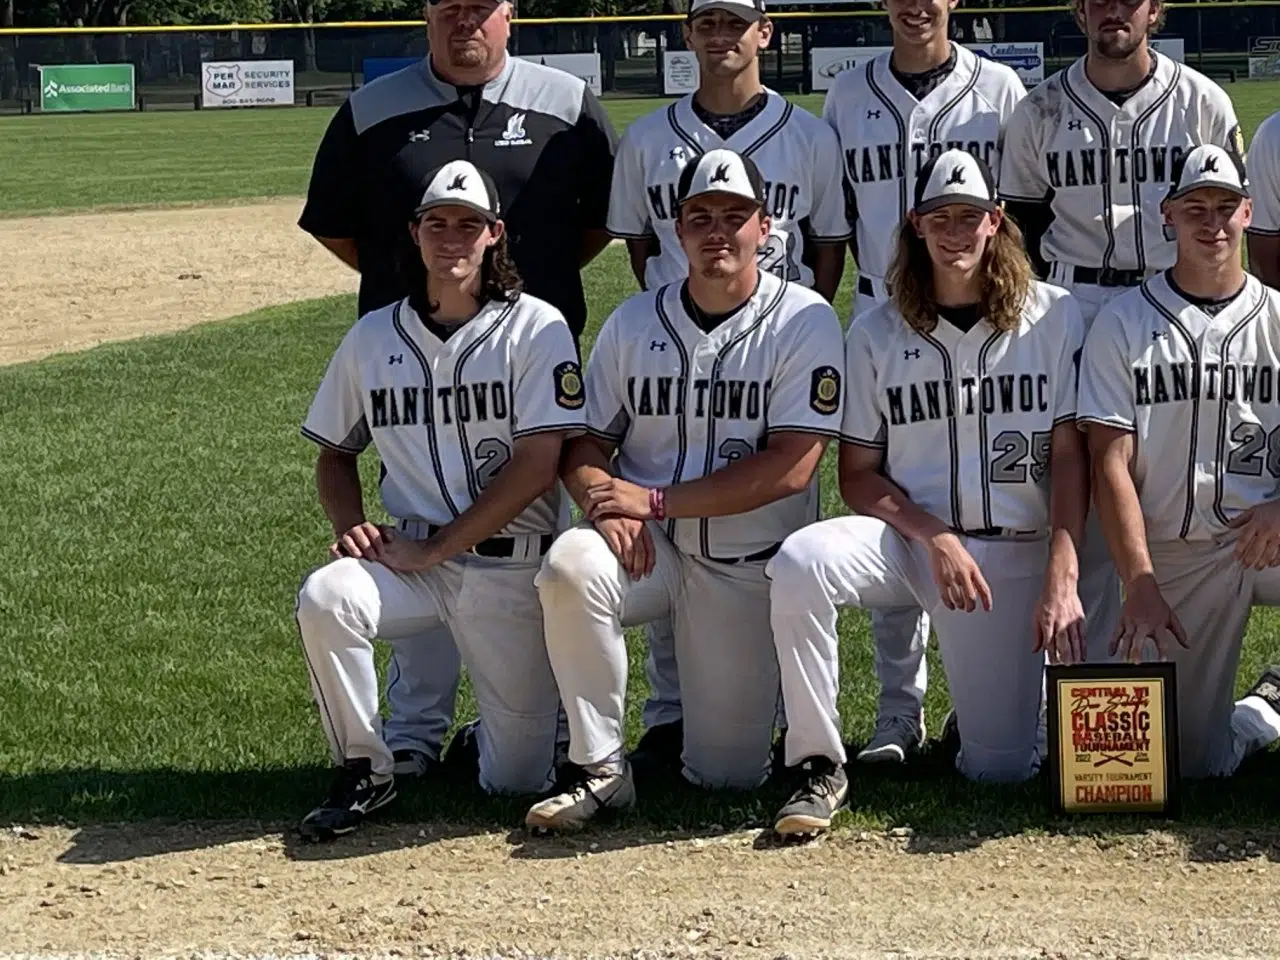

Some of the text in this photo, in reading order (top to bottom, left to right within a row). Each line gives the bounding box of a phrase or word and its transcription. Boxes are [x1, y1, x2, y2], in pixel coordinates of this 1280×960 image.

[213, 72, 234, 80] PER
[244, 70, 291, 80] SECURITY
[60, 83, 110, 94] Associated
[212, 82, 236, 90] MAR
[244, 80, 291, 89] SERVICES
[1046, 146, 1184, 188] MANITOW
[886, 374, 1050, 426] MANITOWOC
[1070, 687, 1127, 698] CENTRAL
[1070, 711, 1151, 731] CLASSIC
[1071, 731, 1150, 742] BASEBALL
[1072, 739, 1151, 752] TOURNAMENT
[1074, 771, 1153, 782] VARSITY TOURNAMENT
[1075, 784, 1153, 803] CHAMPION
